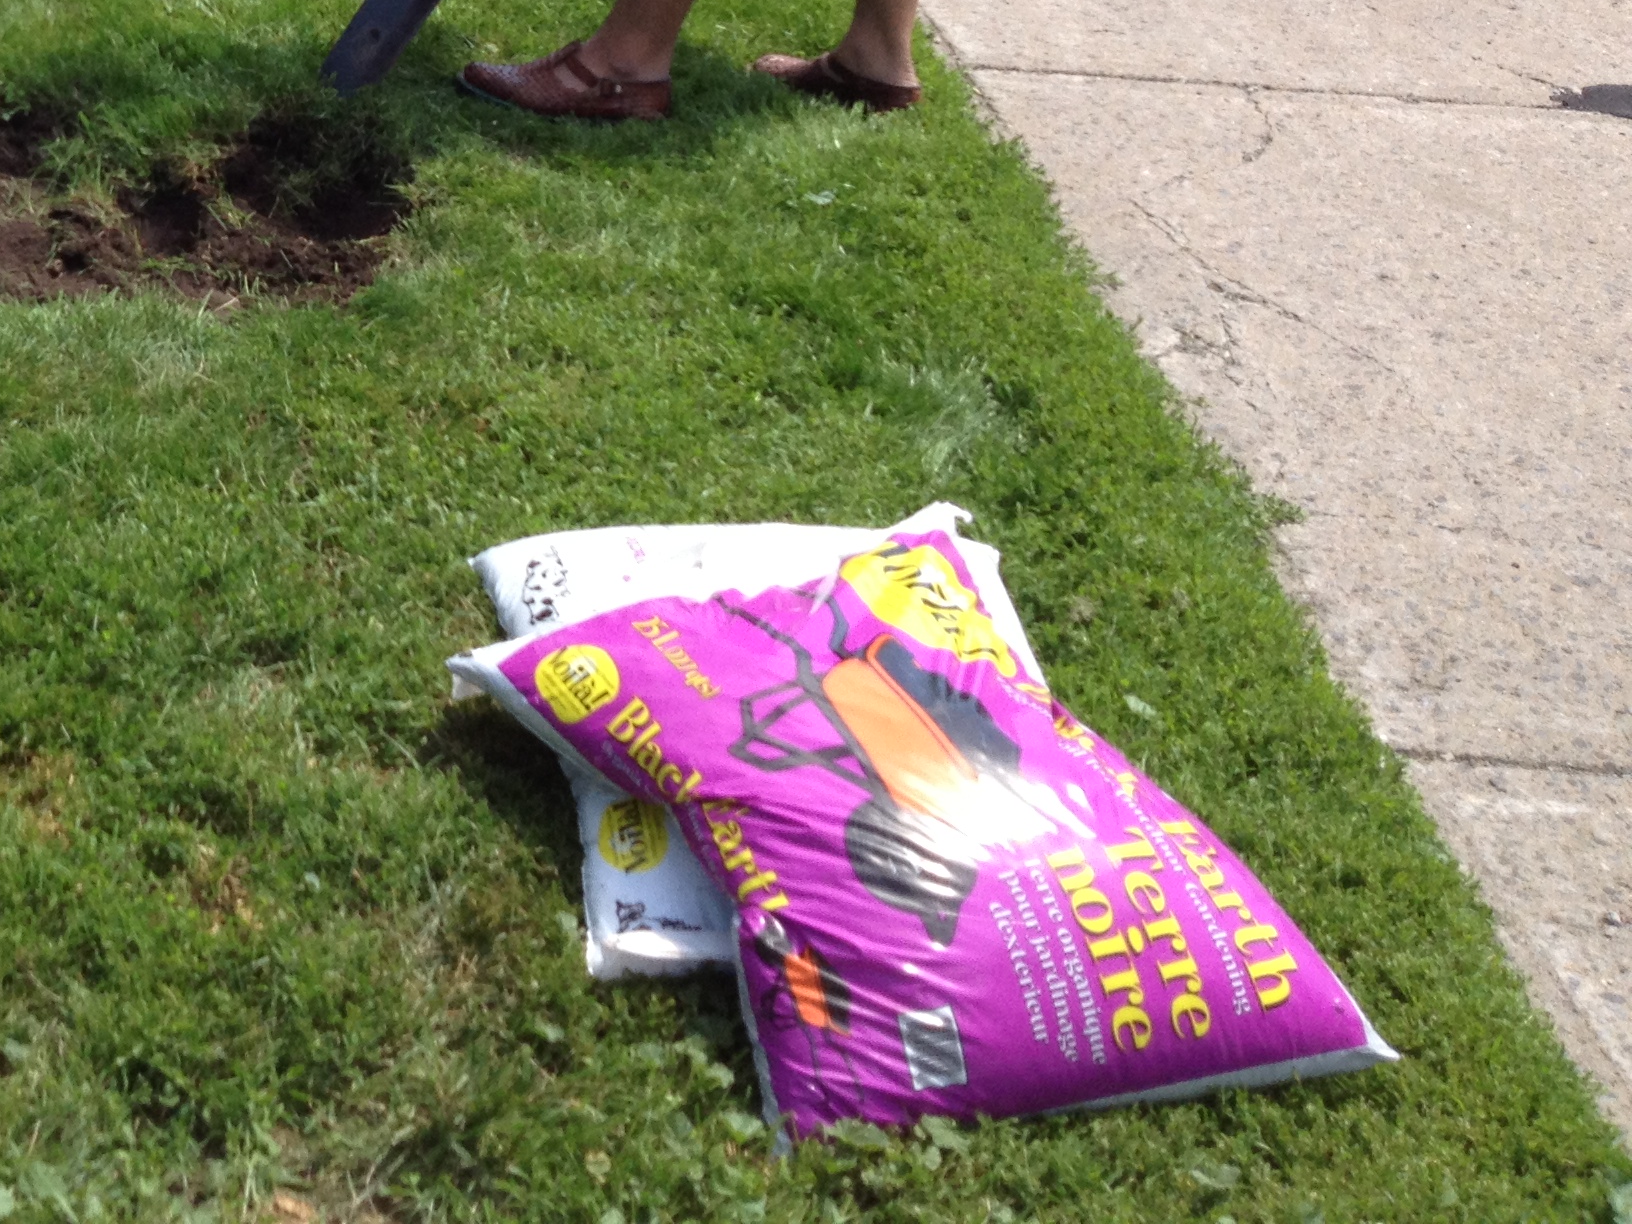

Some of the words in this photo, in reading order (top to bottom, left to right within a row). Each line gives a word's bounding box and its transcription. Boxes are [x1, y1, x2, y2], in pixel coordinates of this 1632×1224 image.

[997, 869, 1042, 933] pour
[1024, 932, 1080, 1064] jardinage
[1045, 843, 1153, 1053] noire
[1055, 926, 1107, 1066] organique
[1103, 826, 1212, 1040] Terre
[1153, 816, 1298, 1014] Earth
